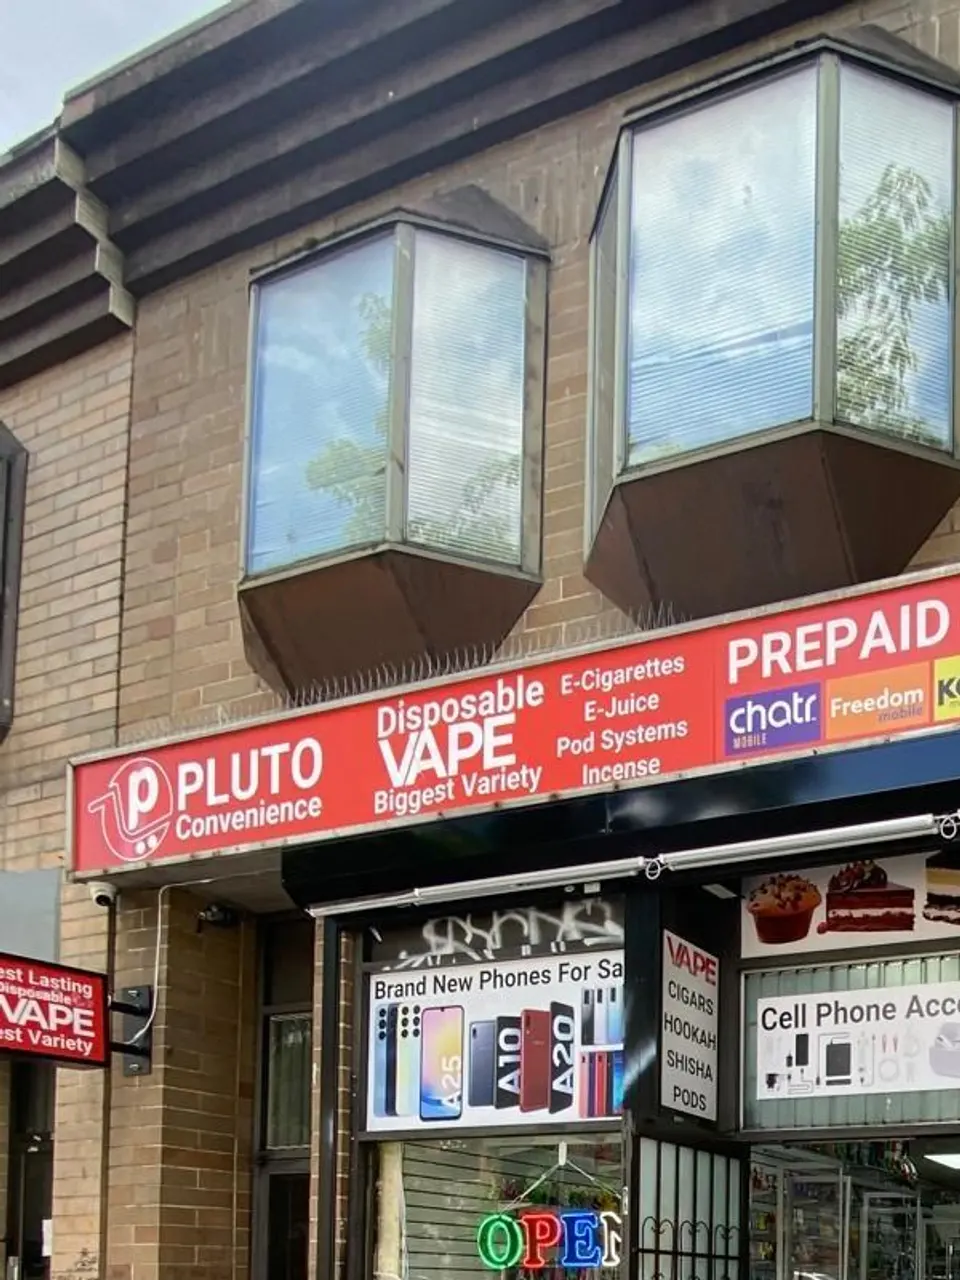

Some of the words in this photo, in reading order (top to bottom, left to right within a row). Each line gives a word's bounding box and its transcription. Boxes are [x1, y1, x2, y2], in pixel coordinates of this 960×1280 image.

[728, 600, 950, 684] PREPAID
[560, 656, 685, 696] E-Cigarettes
[377, 675, 544, 737] Disposable
[584, 691, 659, 722] E-Juice
[729, 690, 817, 734] chatr
[830, 685, 924, 718] Freedom
[878, 704, 924, 723] mobile
[377, 713, 517, 788] VAPE
[557, 733, 595, 758] Pod
[601, 719, 688, 754] Systems
[733, 733, 767, 749] MOBILE
[176, 737, 323, 811] PLUTO
[582, 755, 660, 785] Incense
[374, 781, 455, 820] Biggest
[461, 764, 543, 799] Variety
[175, 795, 322, 841] Convenience
[375, 975, 427, 1000] Brand
[433, 972, 473, 995] New
[480, 967, 551, 990] Phones
[559, 960, 591, 982] For
[598, 958, 622, 979] Sa
[667, 936, 717, 987] VAPE
[28, 970, 92, 999] Lasting
[668, 980, 714, 1016] CIGARS
[0, 994, 95, 1037] VAPE
[664, 1013, 716, 1051] HOOKAH
[761, 1003, 806, 1031] Cell
[816, 998, 897, 1027] Phone
[28, 1029, 93, 1056] Variety
[499, 1027, 520, 1094] A10
[552, 1015, 574, 1094] A20
[441, 1055, 462, 1107] A25
[667, 1051, 713, 1082] SHISHA
[673, 1085, 707, 1111] PODS
[477, 1211, 622, 1270] OPEN
